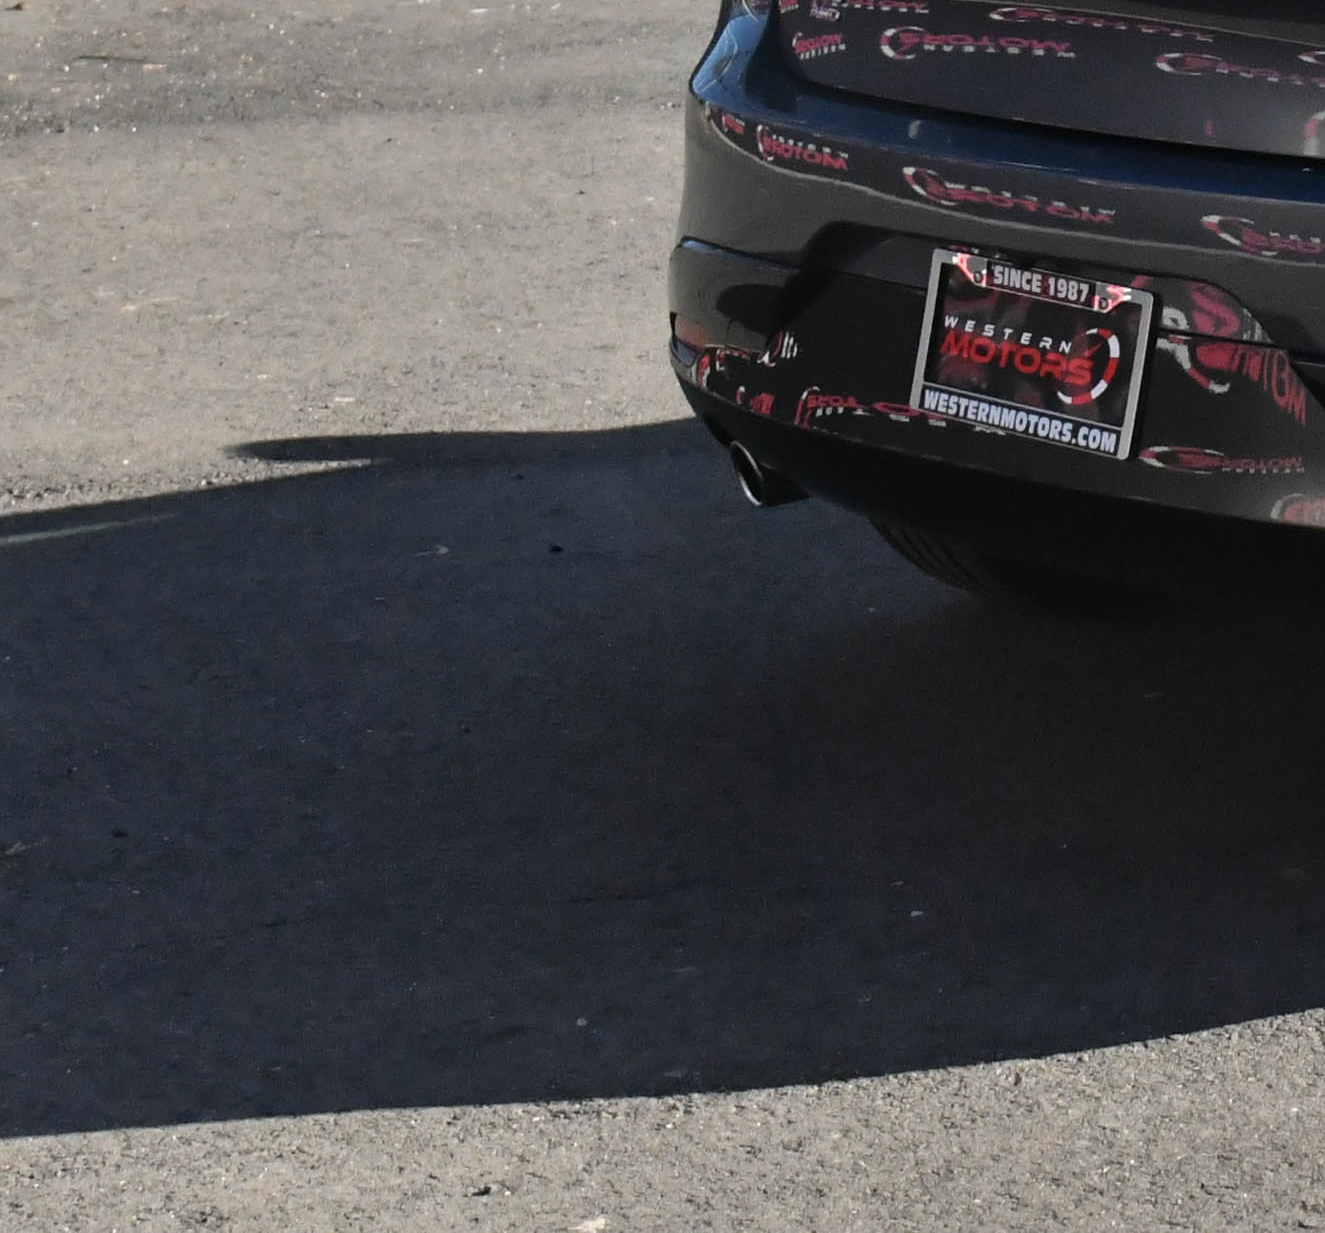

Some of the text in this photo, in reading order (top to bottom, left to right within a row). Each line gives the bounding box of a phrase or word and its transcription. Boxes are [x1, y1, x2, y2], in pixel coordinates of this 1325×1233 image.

[991, 265, 1090, 302] SINCE 1987
[944, 315, 1072, 353] WESTERN
[941, 330, 1093, 386] MOTORS
[924, 389, 1117, 454] WESTERNMOTORS.COM
